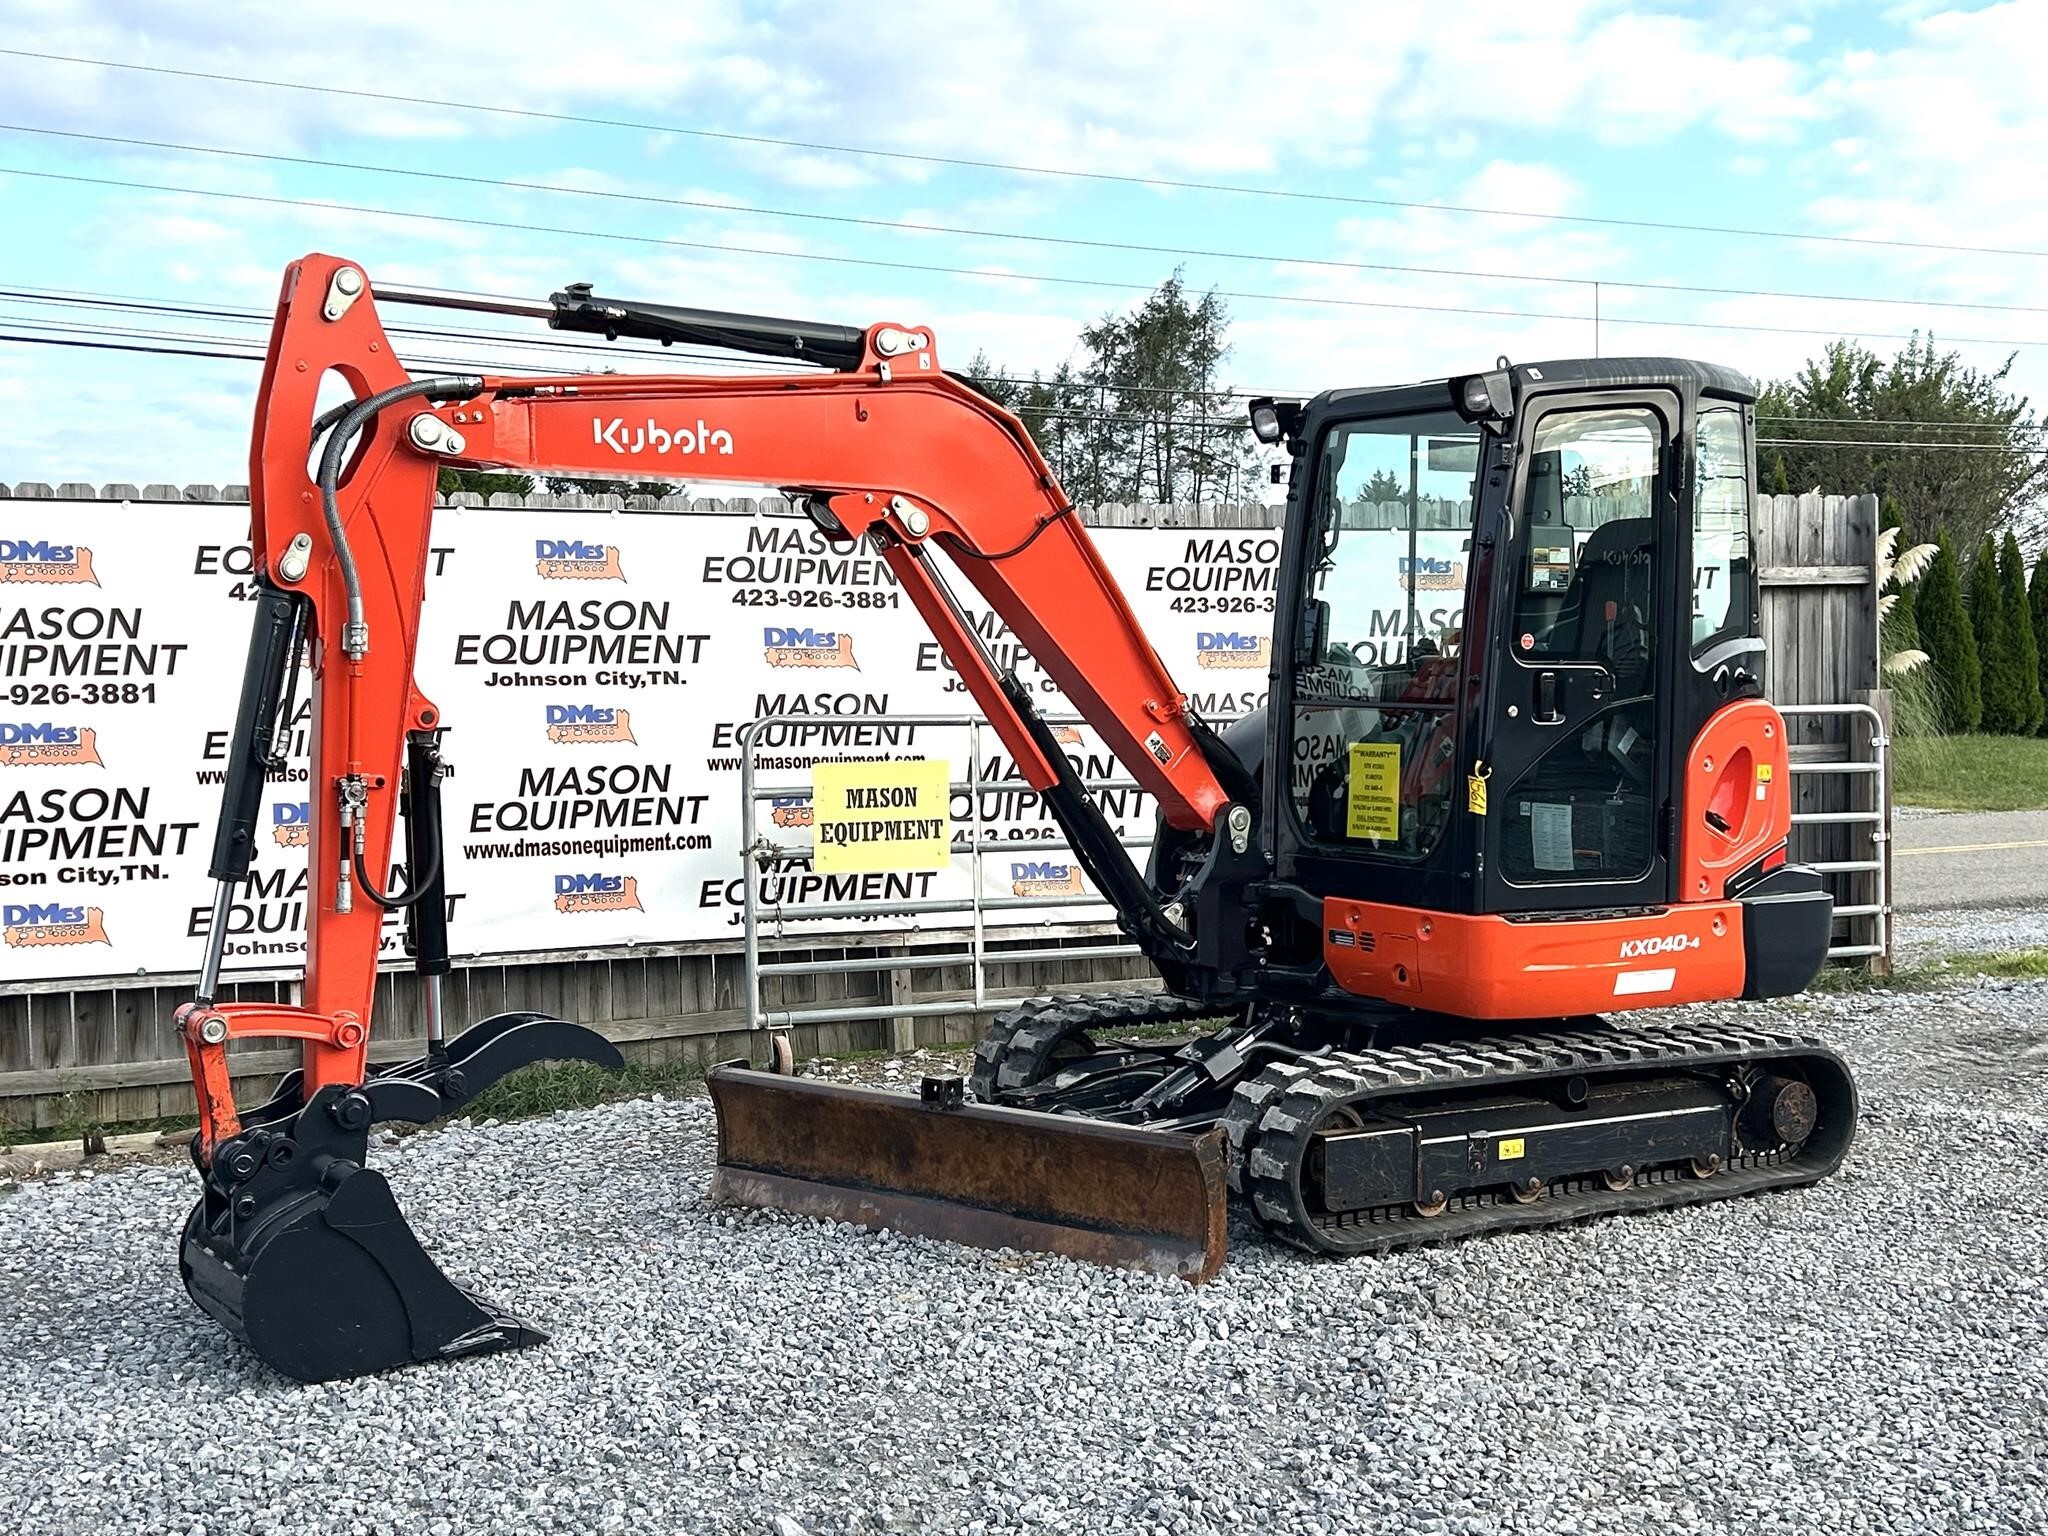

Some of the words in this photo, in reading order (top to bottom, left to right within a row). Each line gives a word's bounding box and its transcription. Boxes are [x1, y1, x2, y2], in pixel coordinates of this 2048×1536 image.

[593, 418, 733, 454] Kubota
[1184, 539, 1280, 564] MASO
[703, 556, 898, 586] EQUIPMEN
[732, 589, 899, 609] 423-926-3881
[1170, 597, 1277, 613] 423-926-3
[0, 608, 142, 640] ASON
[507, 600, 670, 630] MASON
[0, 643, 188, 677] IPMENT
[455, 634, 711, 665] EQUIPMENT
[0, 683, 156, 705] -926-3881
[484, 672, 587, 687] Johnson
[754, 693, 889, 719] MASON
[518, 764, 672, 797] MASON
[0, 787, 150, 824] ASON
[846, 787, 918, 809] MASON
[470, 796, 709, 833] EQUIPMENT
[0, 822, 200, 863] IPMENT
[463, 832, 713, 860] www.dmasonequipment.com
[820, 819, 944, 847] EQUIPMENT
[1619, 933, 1701, 958] KX040-4
